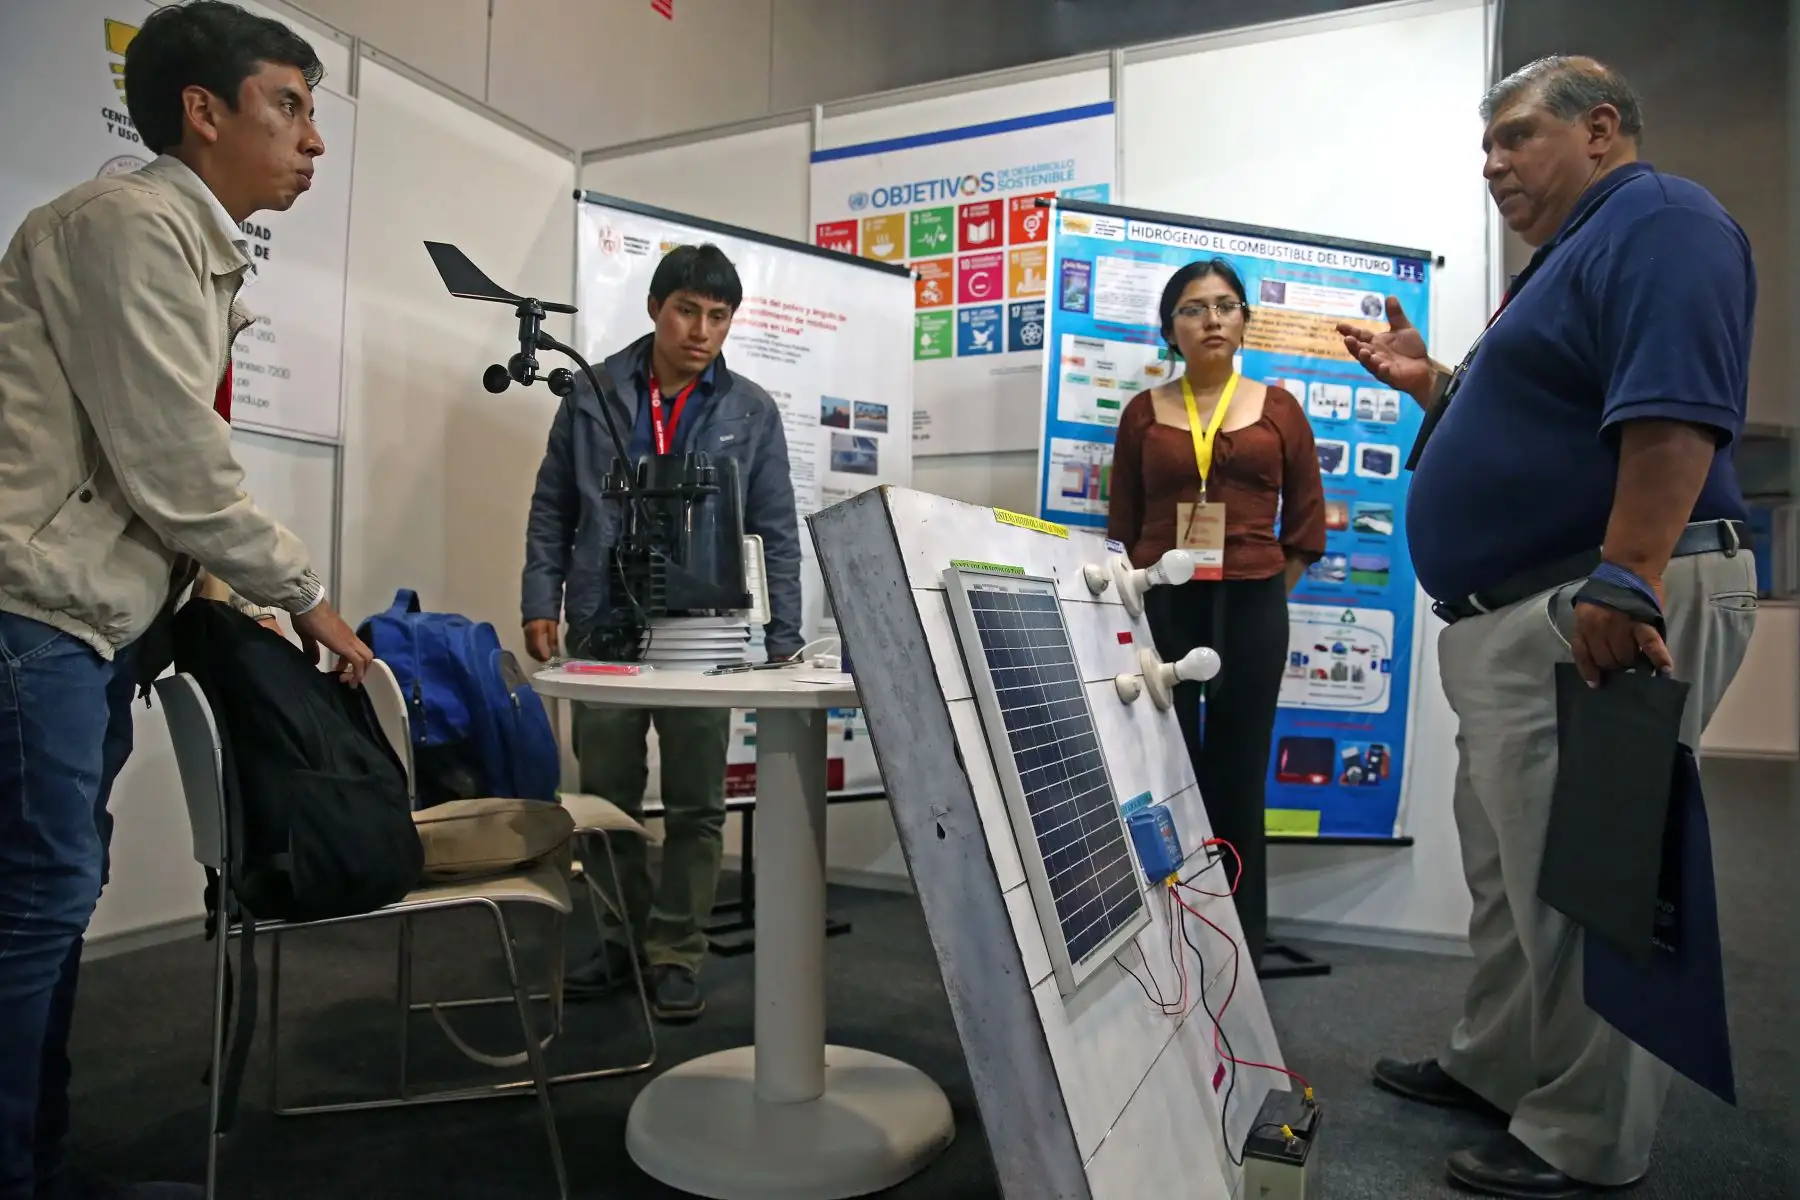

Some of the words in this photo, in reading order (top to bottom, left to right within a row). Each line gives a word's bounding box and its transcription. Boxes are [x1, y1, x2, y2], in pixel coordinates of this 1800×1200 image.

[106, 121, 115, 134] Y
[118, 127, 139, 143] USO
[1012, 159, 1075, 176] DESARROLLO
[871, 172, 995, 209] OBJETIVOS
[997, 169, 1075, 191] SOSTENIBLE
[962, 207, 969, 218] 4
[239, 220, 271, 240] IDAD
[255, 243, 270, 260] DE
[1130, 223, 1208, 247] HIDRÓGENO
[1213, 236, 1226, 249] EL
[1229, 238, 1314, 262] COMBUSTIBLE
[1318, 252, 1340, 265] DEL
[1343, 255, 1390, 273] FUTURO
